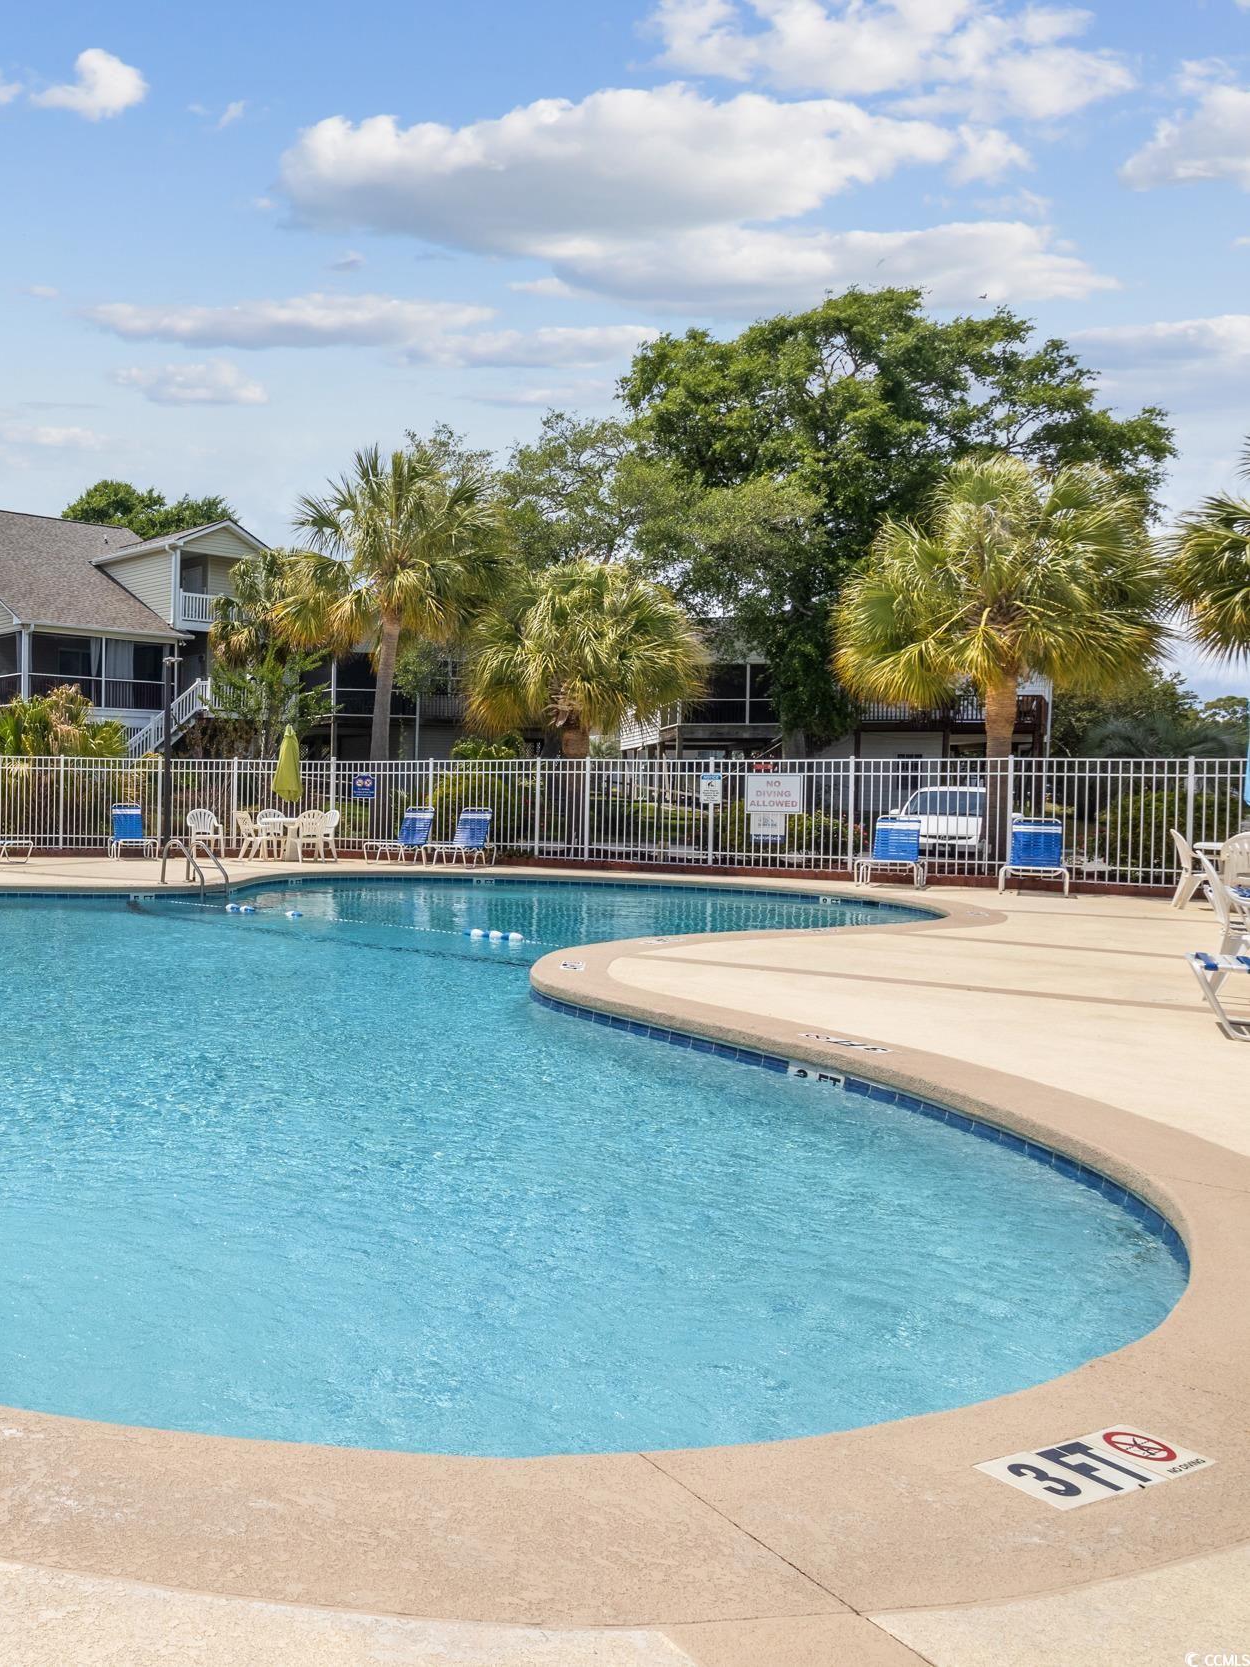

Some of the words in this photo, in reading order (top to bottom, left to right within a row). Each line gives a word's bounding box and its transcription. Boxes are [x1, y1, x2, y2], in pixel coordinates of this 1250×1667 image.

[766, 780, 782, 788] NO
[755, 790, 792, 798] DIVING
[750, 800, 799, 808] ALLOWED
[1034, 1440, 1153, 1492] FT
[1166, 1466, 1183, 1474] NO
[1178, 1458, 1206, 1470] DIVING
[1006, 1462, 1083, 1498] 3
